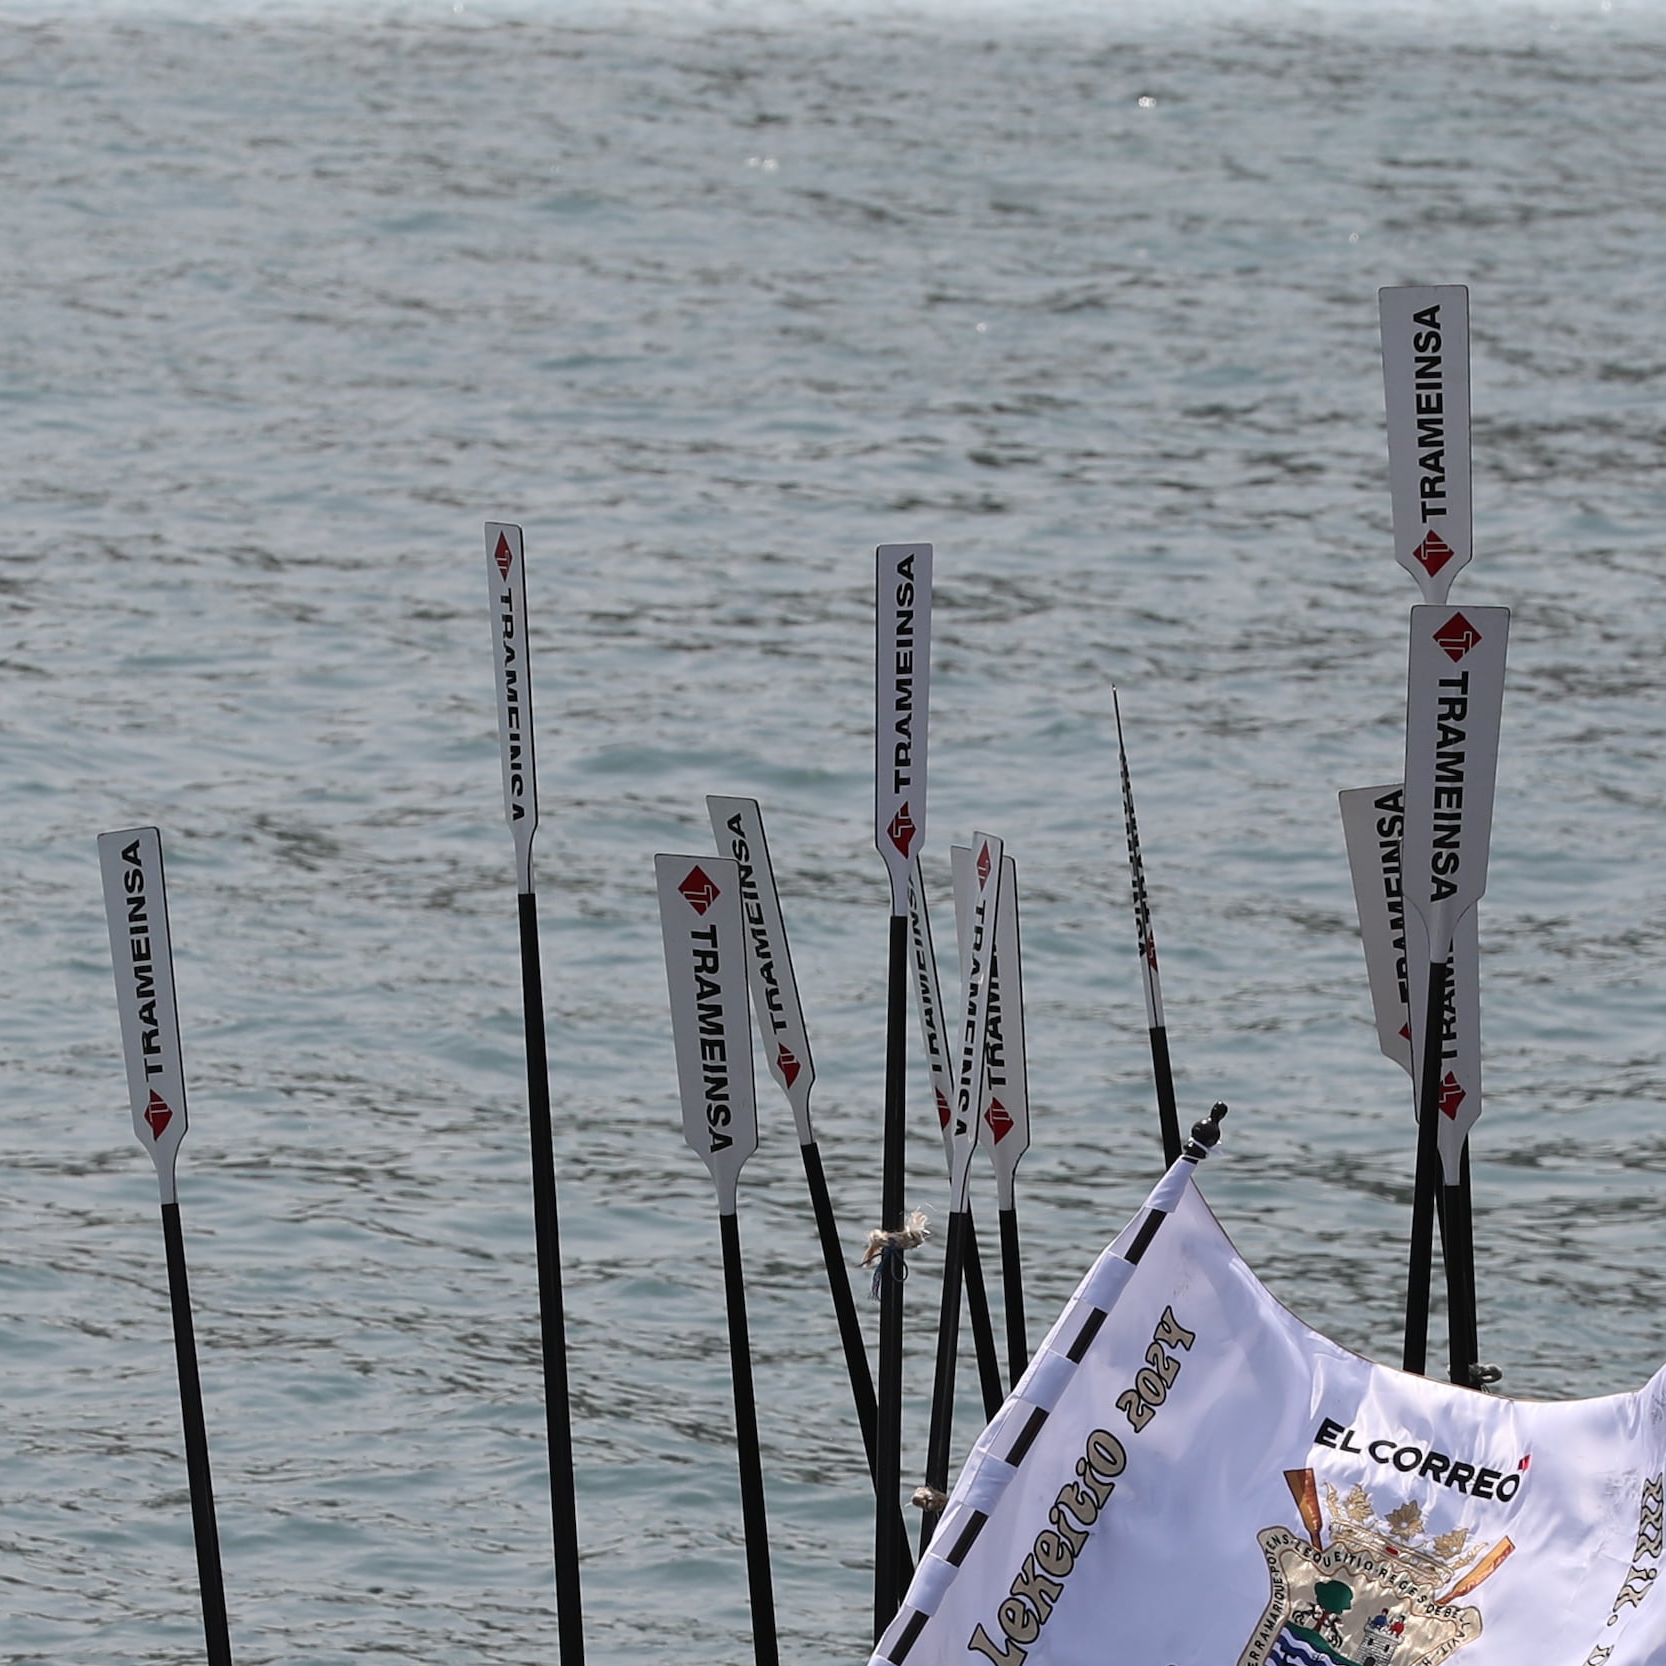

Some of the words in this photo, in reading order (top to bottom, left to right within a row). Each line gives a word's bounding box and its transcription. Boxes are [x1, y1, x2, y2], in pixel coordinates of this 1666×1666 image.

[1413, 304, 1447, 523] TRAMEINSA
[894, 553, 915, 794] TRAMEINSA
[1430, 671, 1469, 903] TRAMEINSA
[121, 838, 163, 1082] TRAMEINSA
[727, 813, 787, 1034] TRAMEINSA
[691, 924, 734, 1153] TRAMEINSA
[1117, 1305, 1196, 1433] 2024
[1368, 1440, 1520, 1502] CORREO
